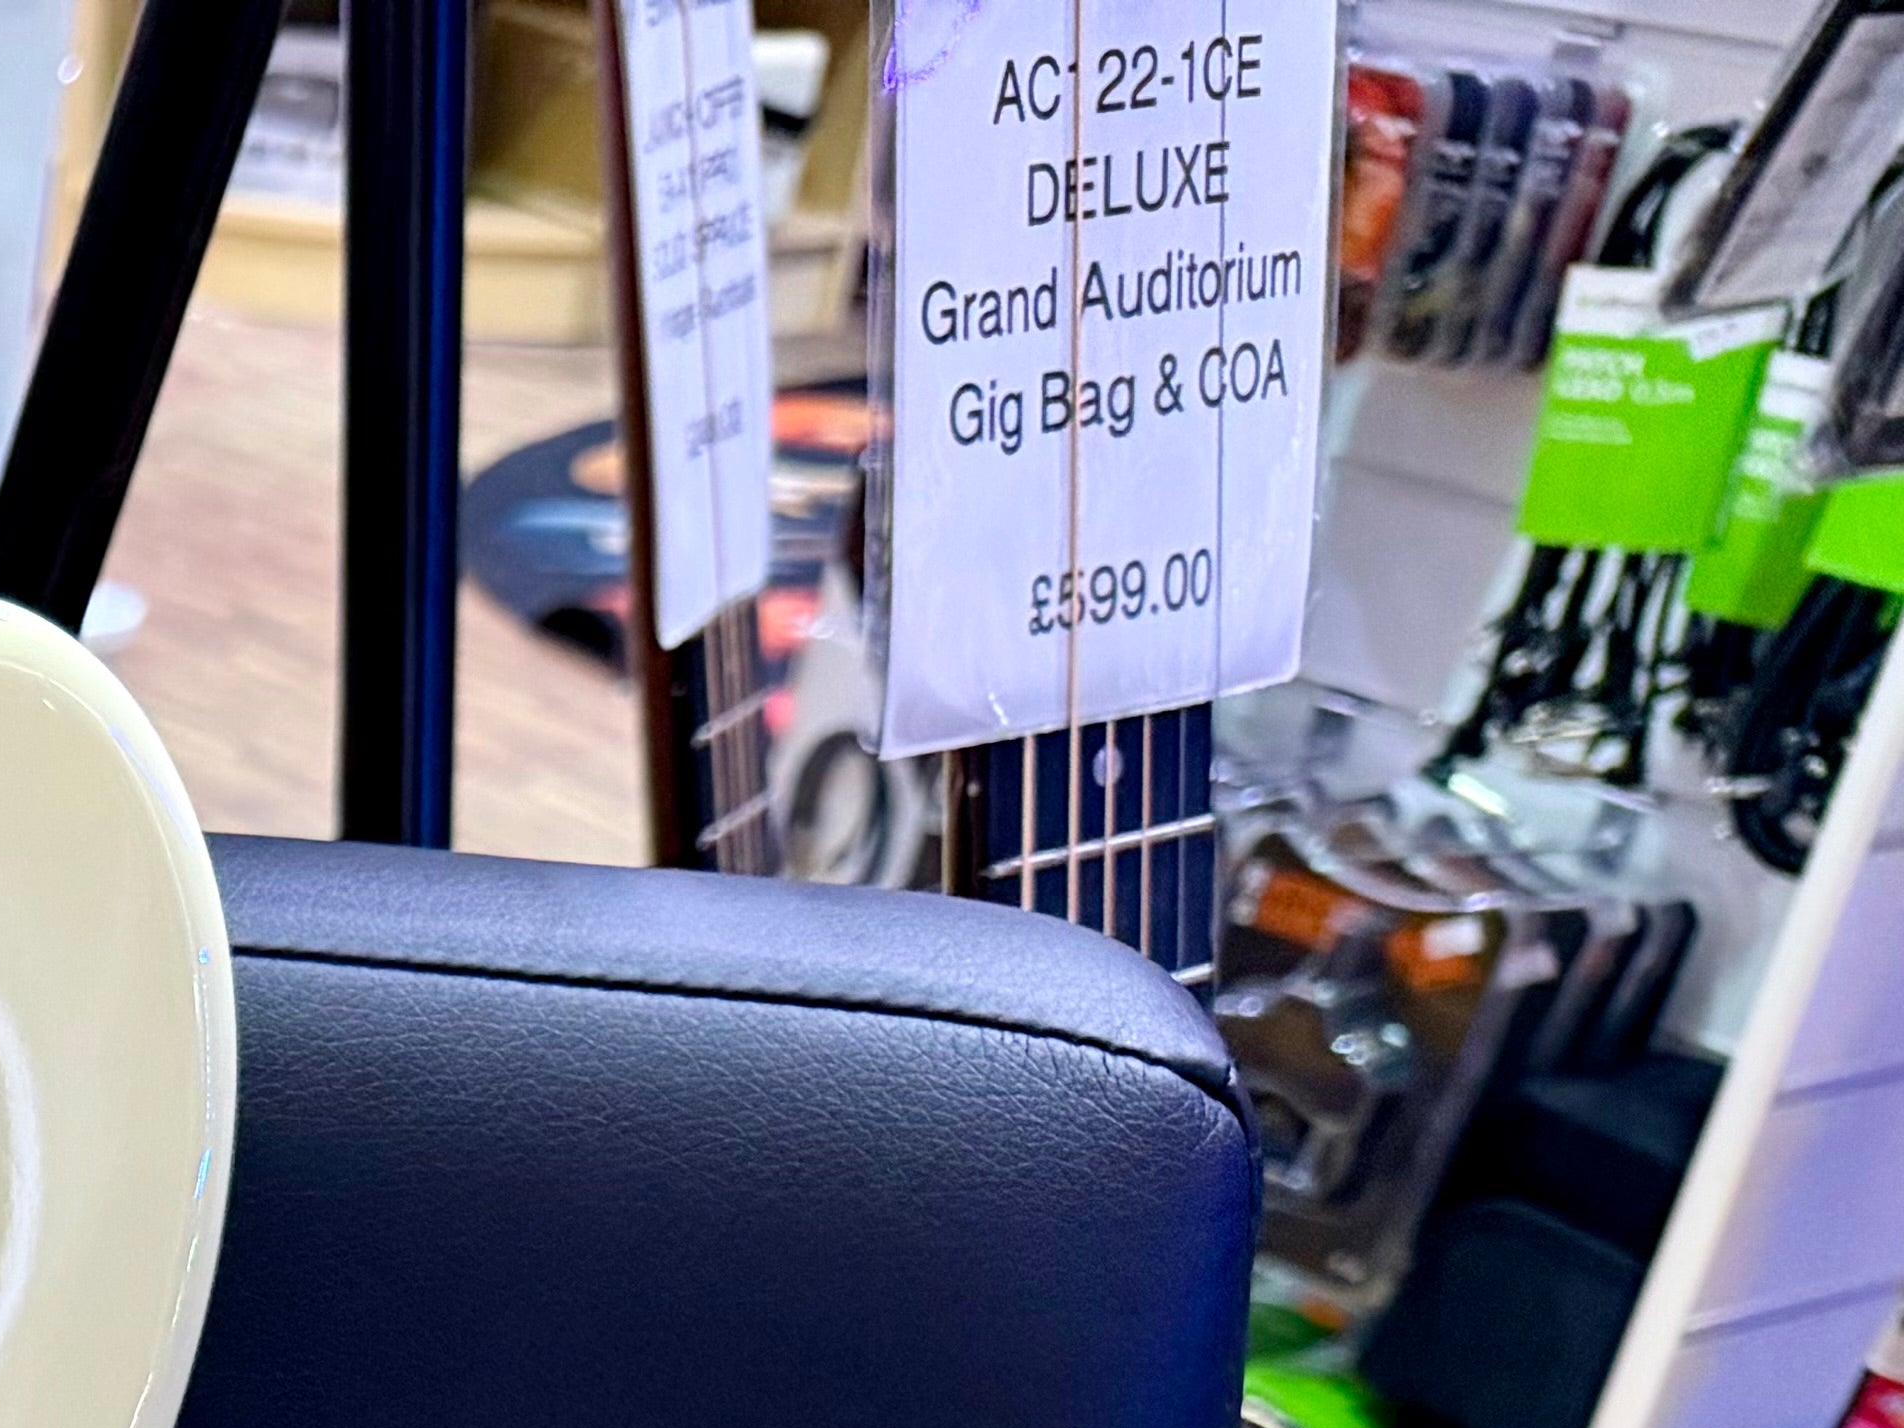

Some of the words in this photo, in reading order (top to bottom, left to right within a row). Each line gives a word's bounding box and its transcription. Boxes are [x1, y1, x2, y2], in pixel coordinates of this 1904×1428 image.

[1027, 141, 1230, 226] DELUXE
[922, 266, 1057, 345] Grand
[1080, 243, 1301, 321] Auditorium
[950, 380, 1022, 455] Gig
[1041, 370, 1135, 438] Bag
[1154, 354, 1184, 415] &
[1199, 338, 1288, 408] COA
[1029, 548, 1212, 636] £599.00
